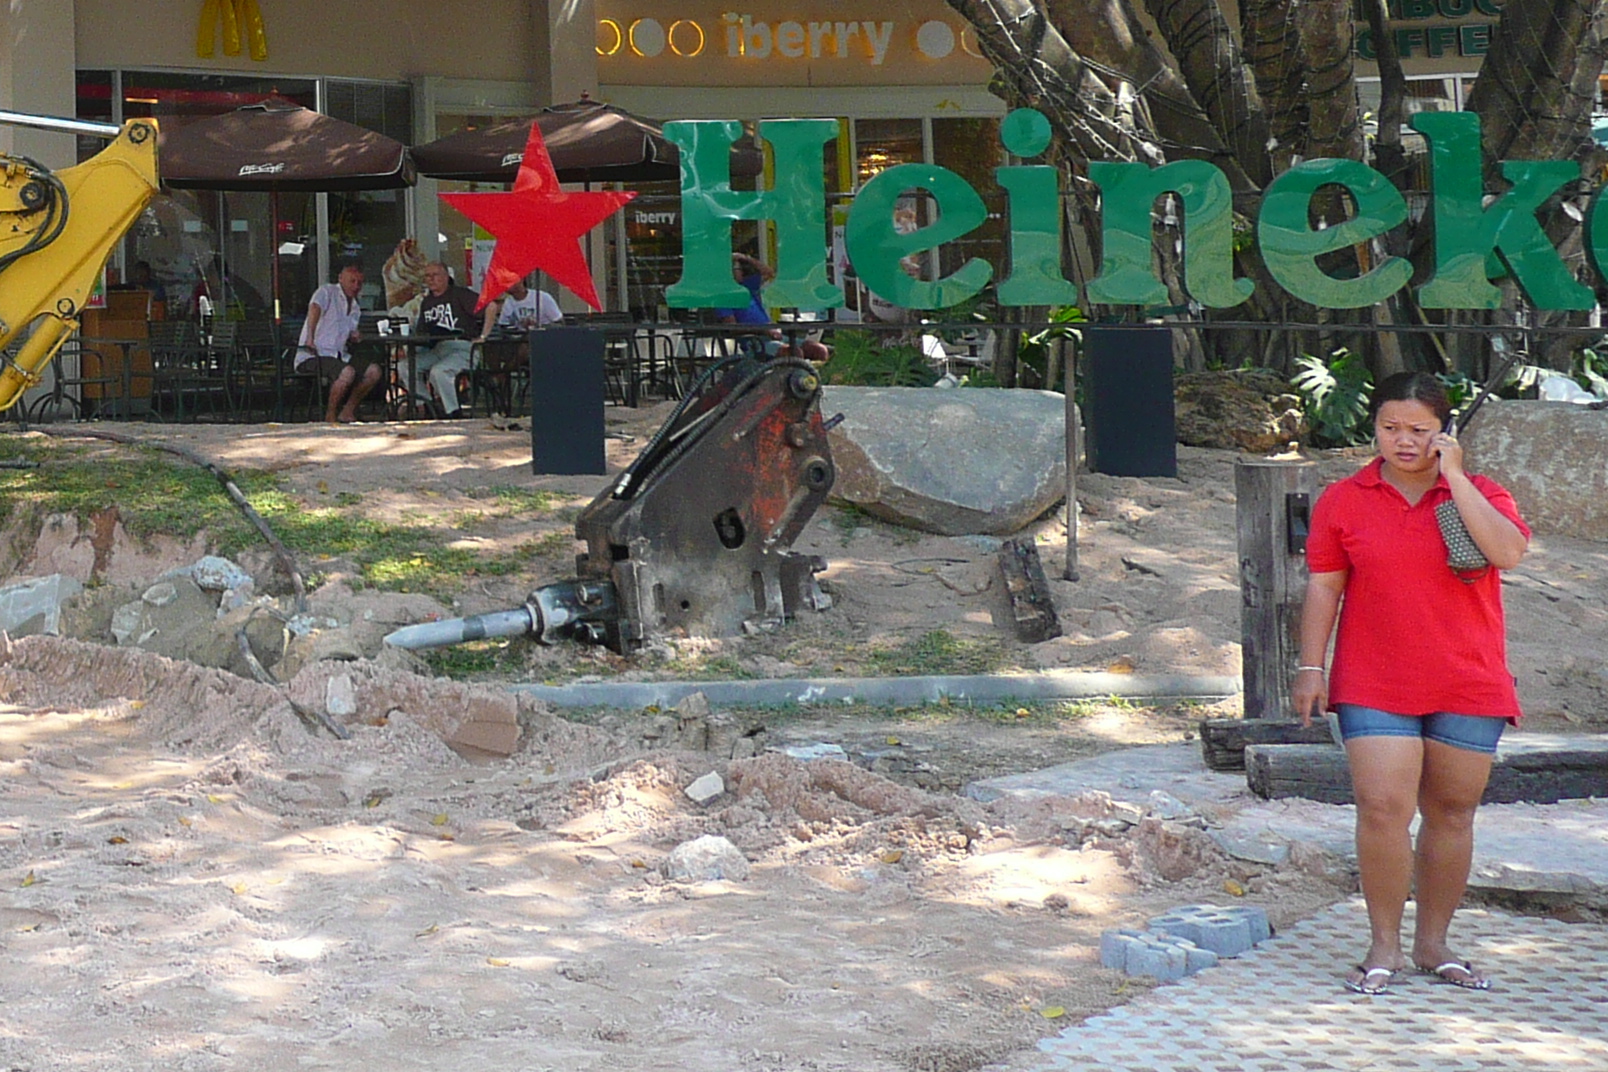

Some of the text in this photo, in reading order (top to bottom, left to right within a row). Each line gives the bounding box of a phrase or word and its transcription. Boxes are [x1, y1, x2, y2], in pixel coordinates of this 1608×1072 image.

[723, 11, 894, 65] iberry
[635, 210, 677, 225] iberry
[662, 106, 1608, 312] Heinek
